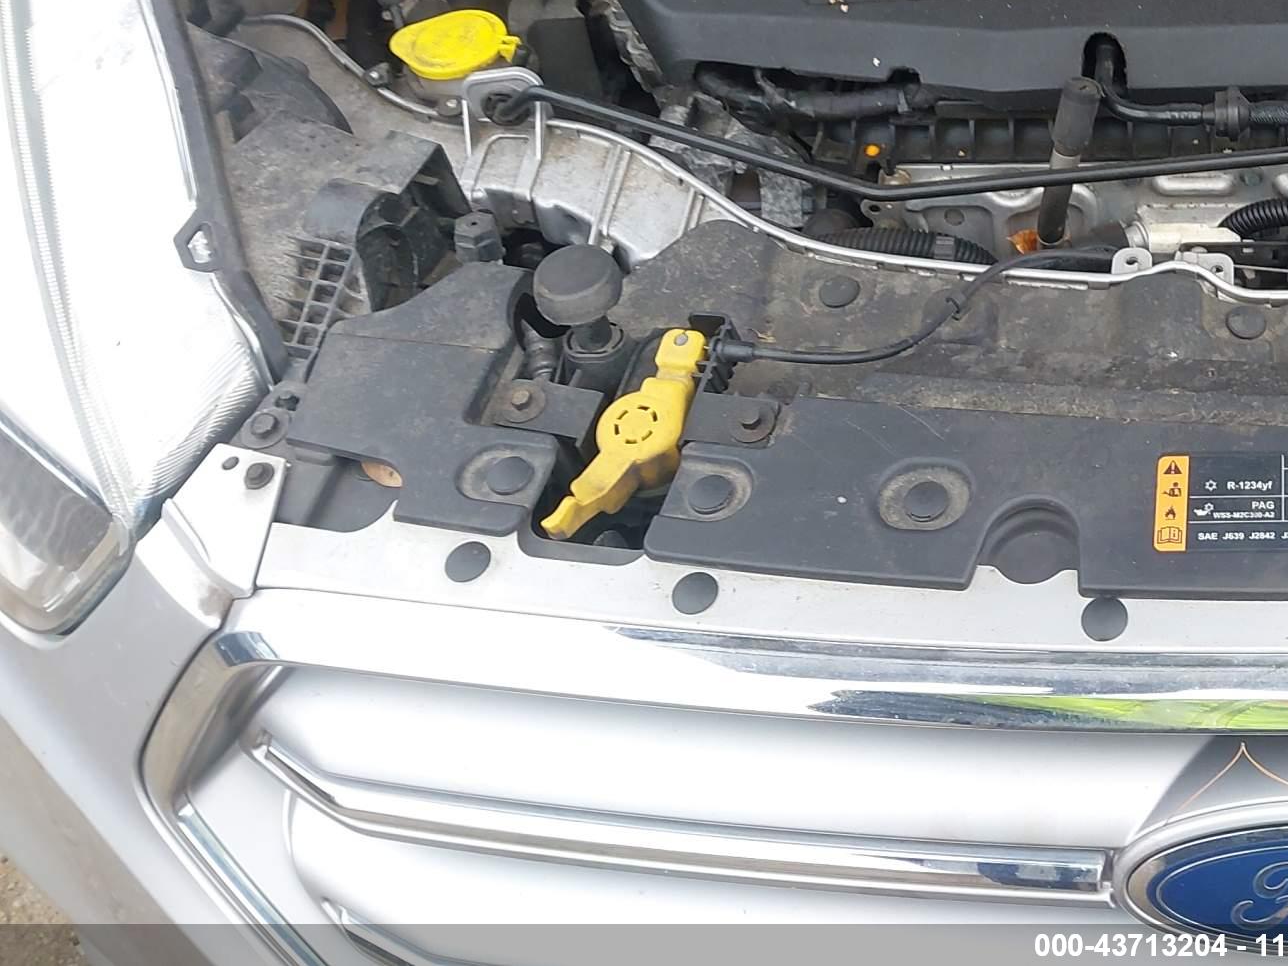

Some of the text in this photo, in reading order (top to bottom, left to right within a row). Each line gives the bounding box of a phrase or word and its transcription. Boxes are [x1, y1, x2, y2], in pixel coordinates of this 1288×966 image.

[1226, 480, 1273, 491] R-1234yf
[1251, 500, 1275, 509] PAG
[1197, 532, 1218, 540] SAE
